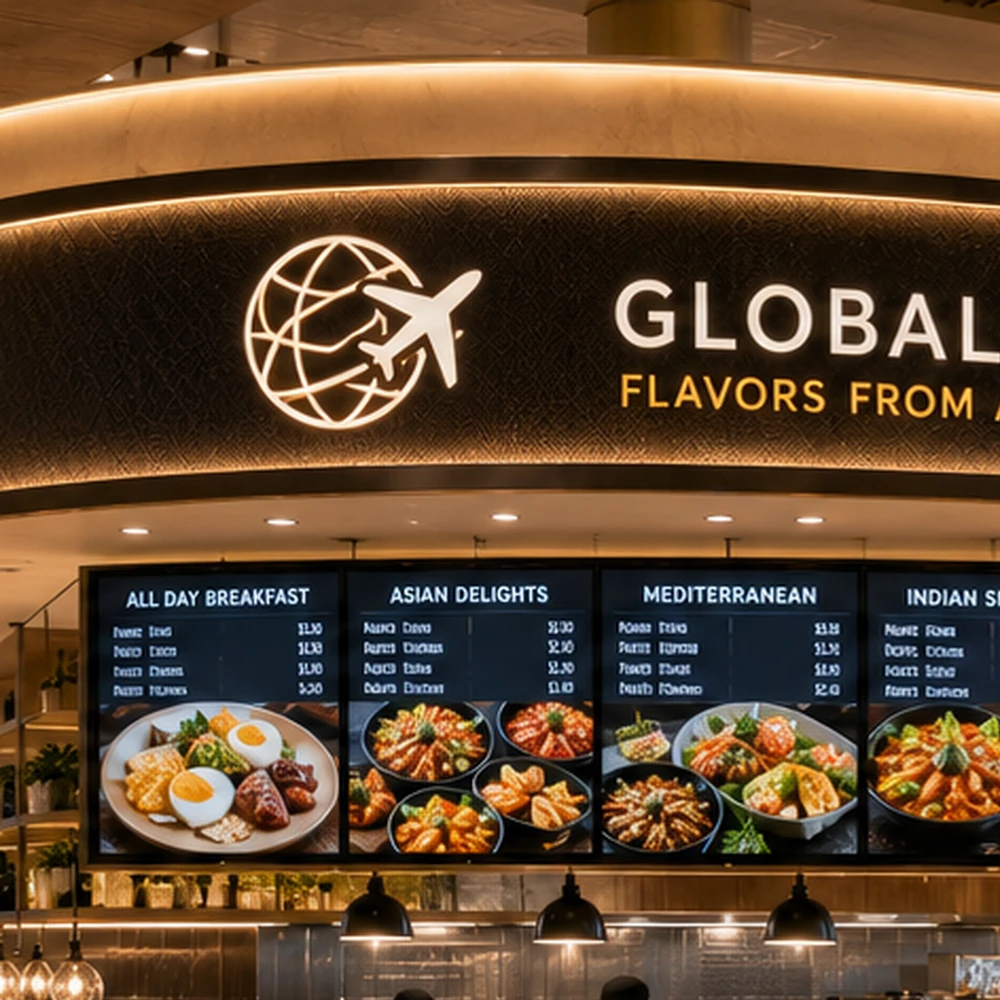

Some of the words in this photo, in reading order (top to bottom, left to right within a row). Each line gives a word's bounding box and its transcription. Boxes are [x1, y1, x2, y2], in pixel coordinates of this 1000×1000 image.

[620, 373, 826, 414] FLAVORS
[850, 380, 974, 420] FROM
[126, 590, 160, 608] ALL
[163, 590, 200, 608] DAY
[205, 587, 311, 607] BREAKFAST
[389, 586, 448, 605] ASIAN
[455, 585, 549, 604] DELIGHTS
[643, 585, 817, 605] MEDITERRANEAN
[907, 588, 978, 607] INDIAN
